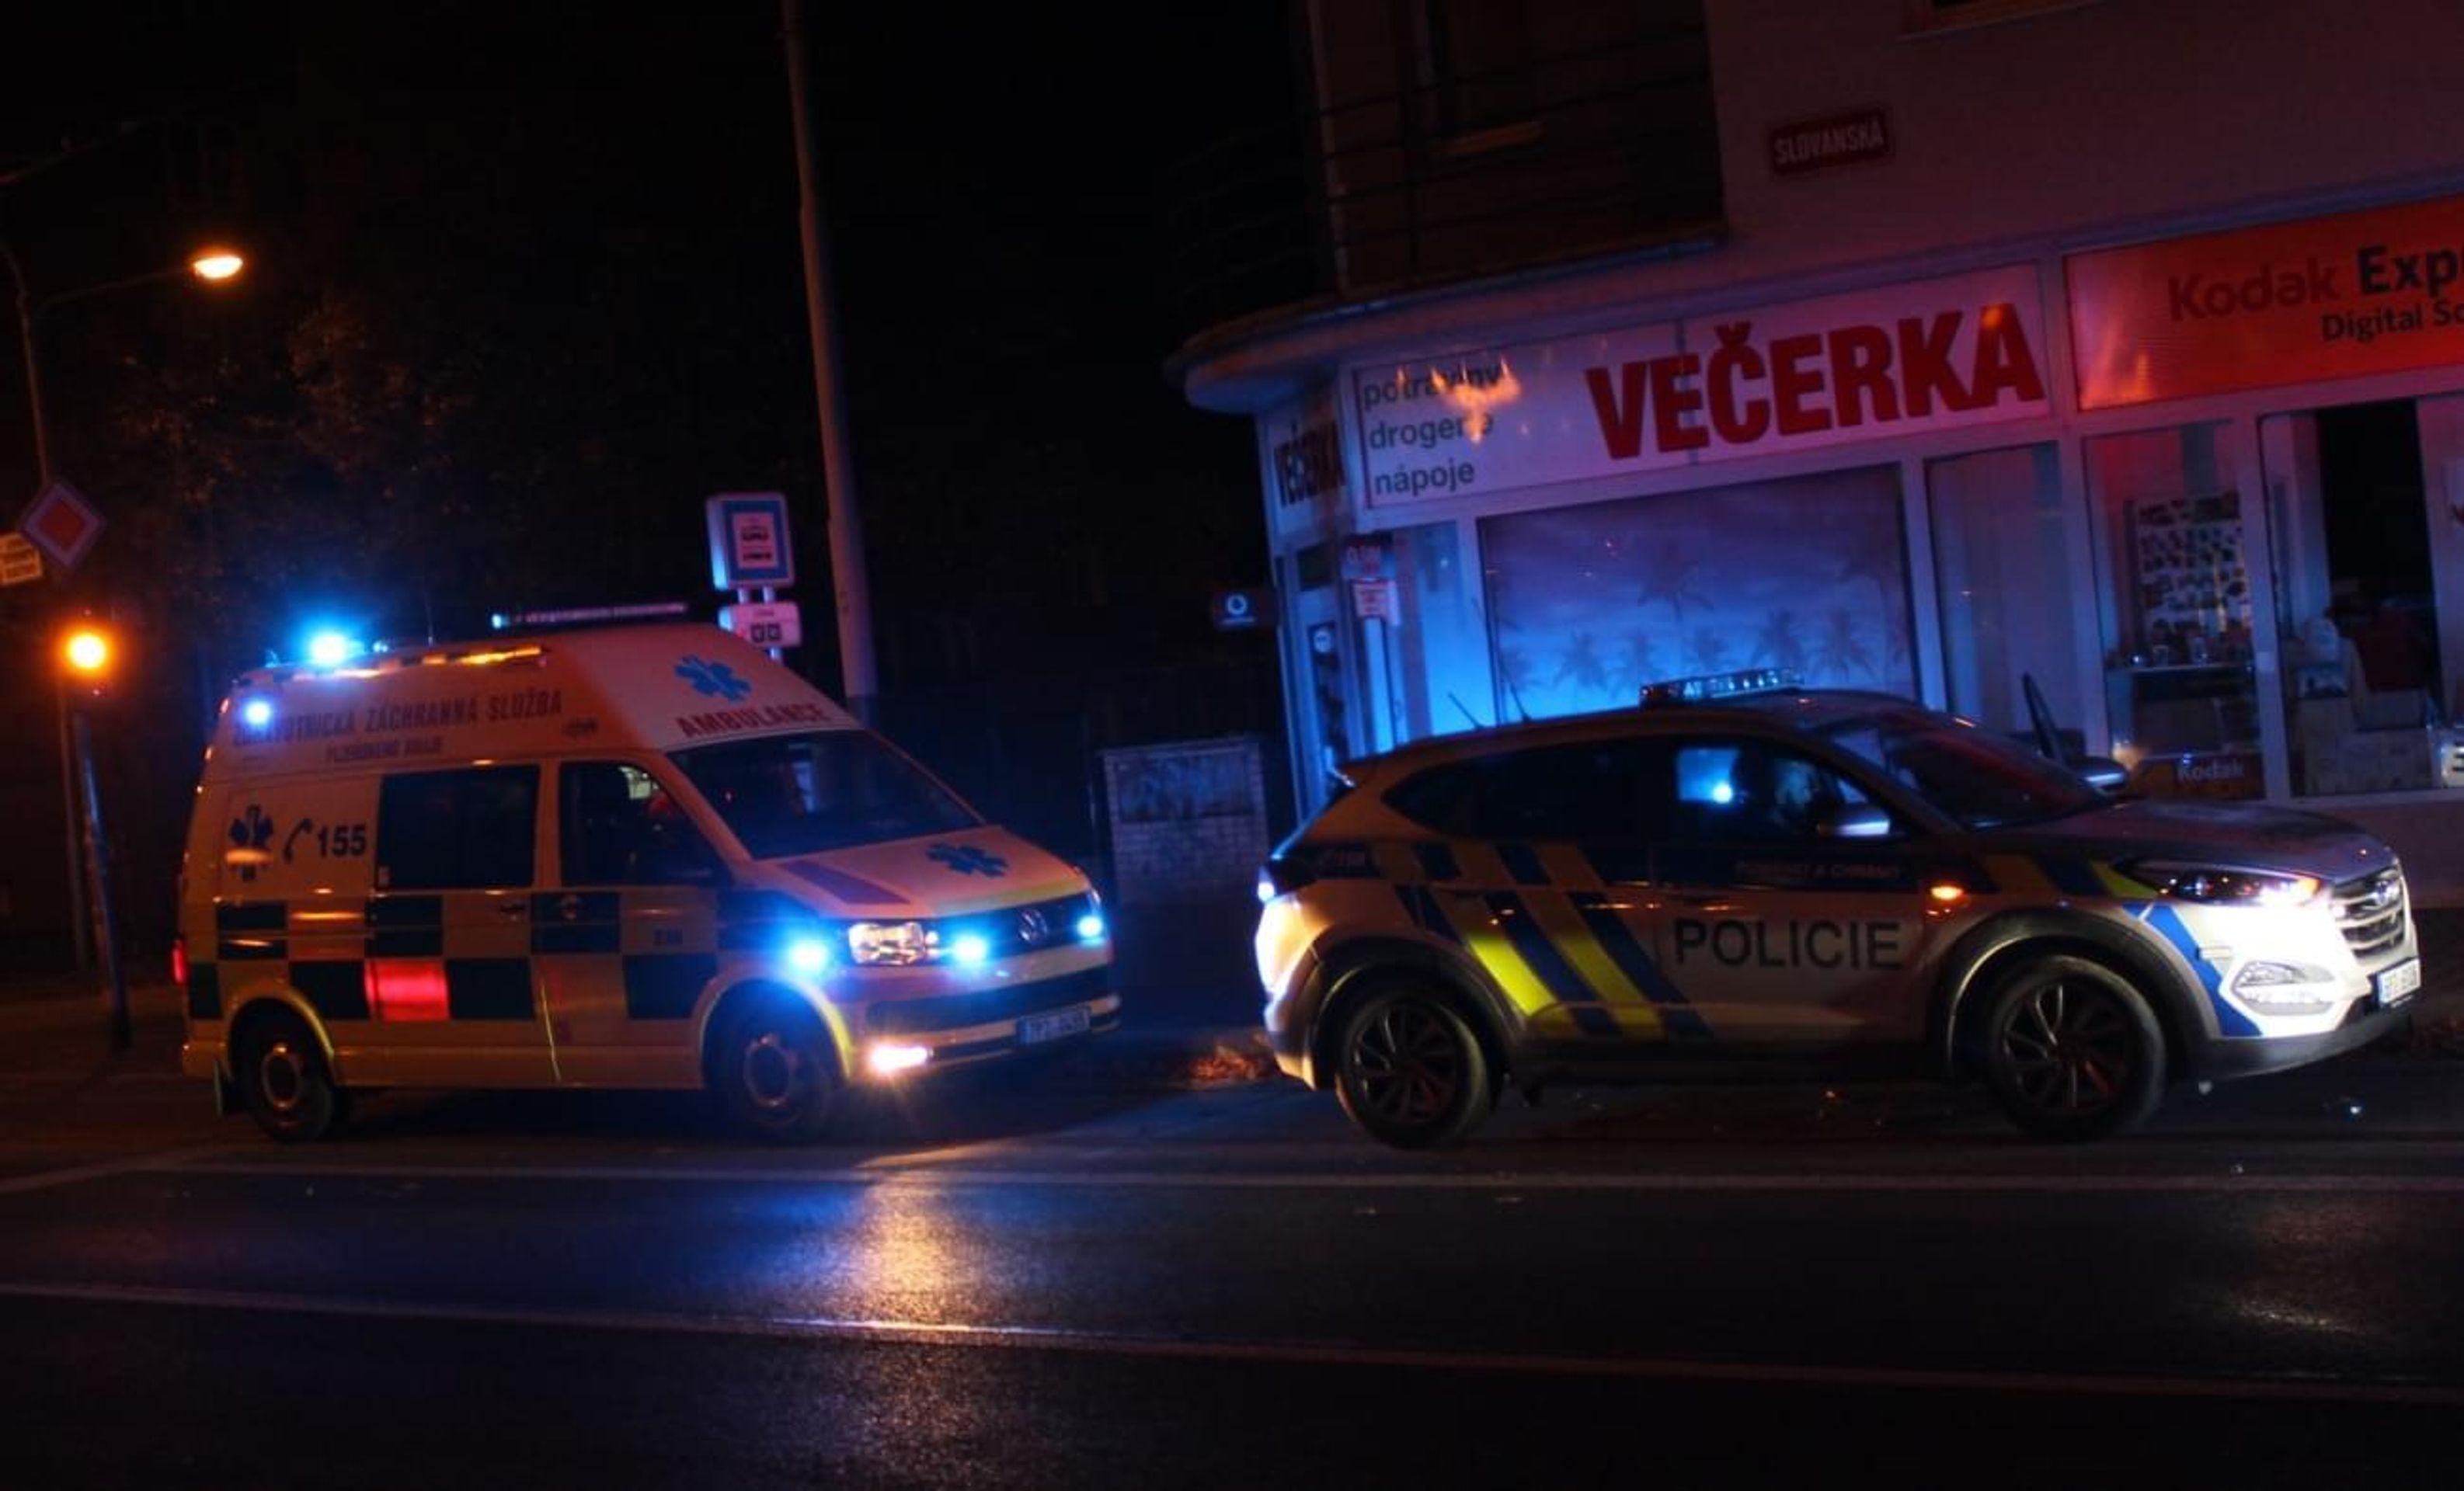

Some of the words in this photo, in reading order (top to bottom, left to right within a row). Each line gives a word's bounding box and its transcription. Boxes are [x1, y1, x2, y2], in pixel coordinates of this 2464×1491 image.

[2167, 257, 2340, 321] Kodak
[2358, 245, 2464, 298] Exp
[2322, 303, 2424, 343] Digital
[1585, 303, 2045, 460] VEČERKA
[1369, 412, 1495, 450] drogere
[1374, 457, 1475, 497] nápoje
[674, 704, 830, 738] AMBULANCE
[318, 824, 367, 857] 155
[1674, 919, 1905, 971] POLICIE
